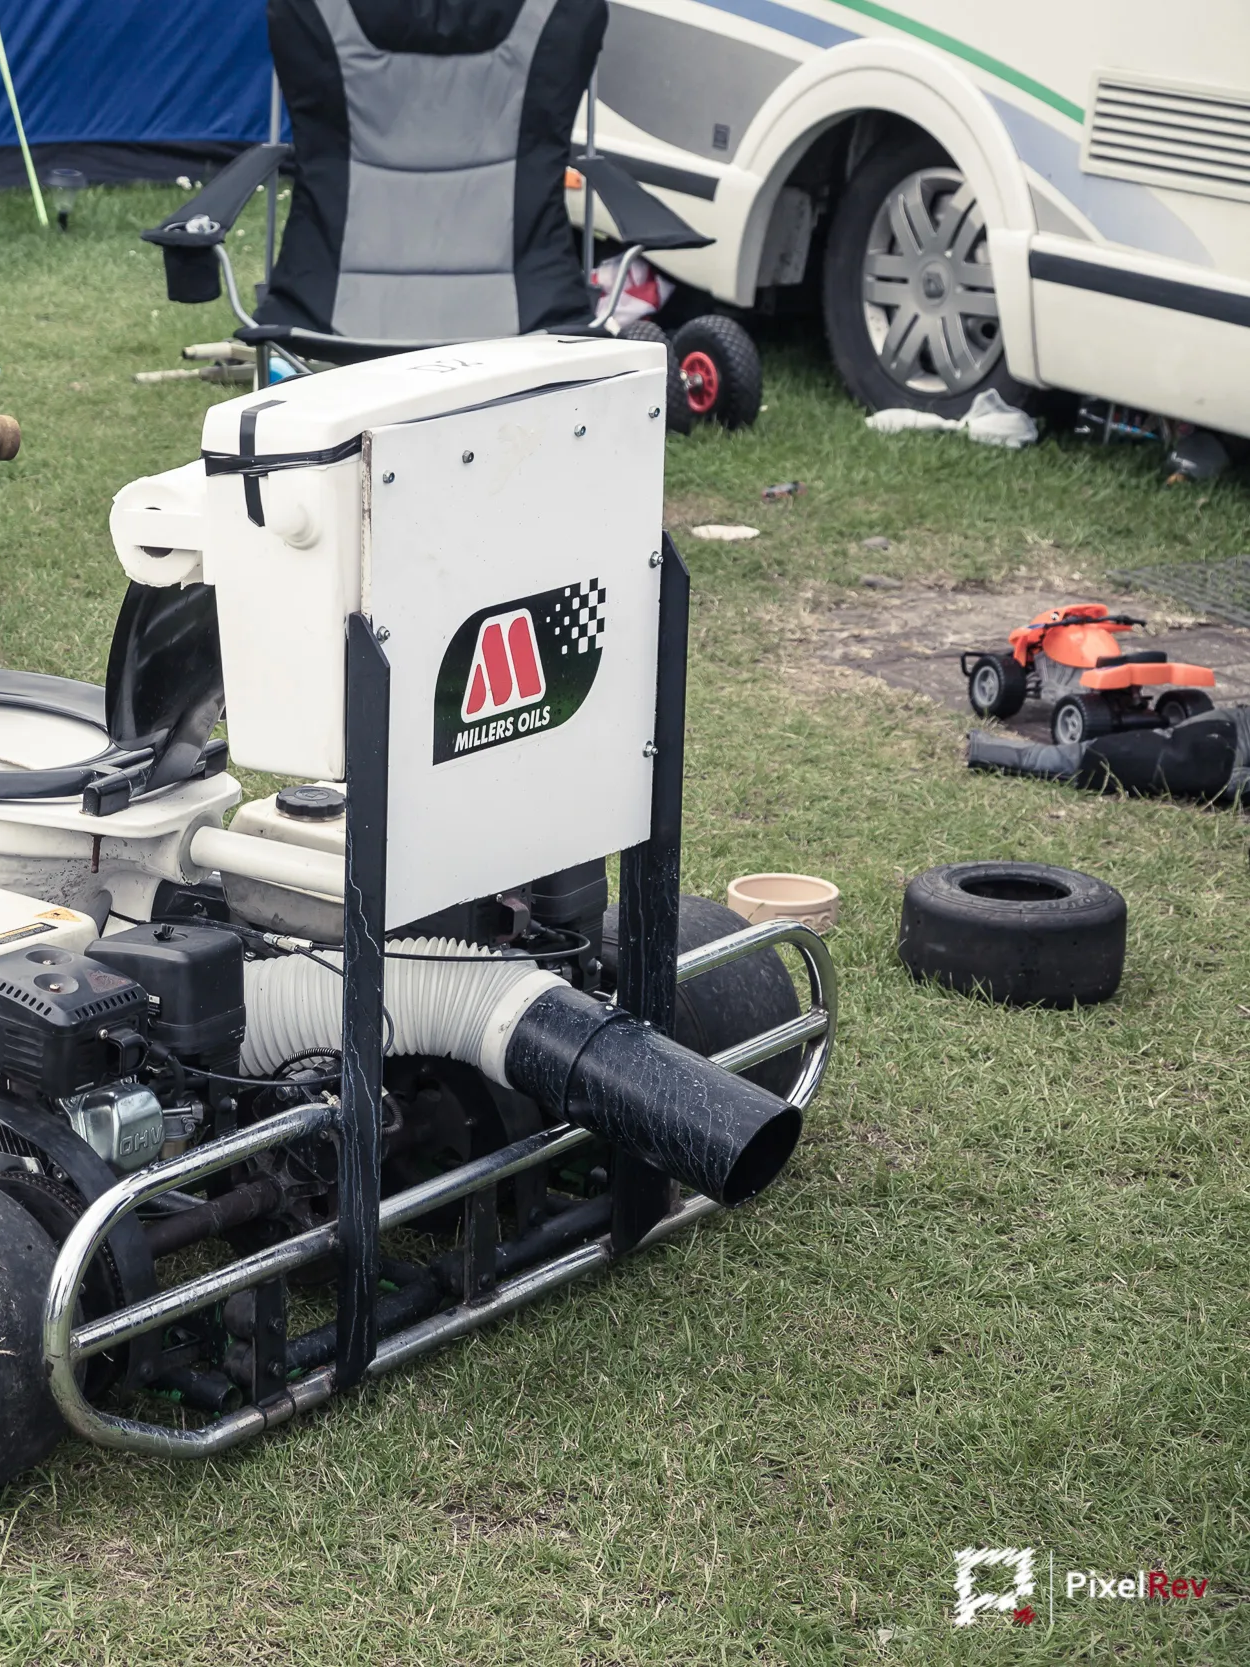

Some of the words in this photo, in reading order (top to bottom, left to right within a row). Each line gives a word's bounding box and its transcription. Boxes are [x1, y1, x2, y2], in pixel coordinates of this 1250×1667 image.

[454, 716, 514, 753] MILLERS
[517, 705, 551, 733] OILS
[119, 1124, 163, 1155] OHV
